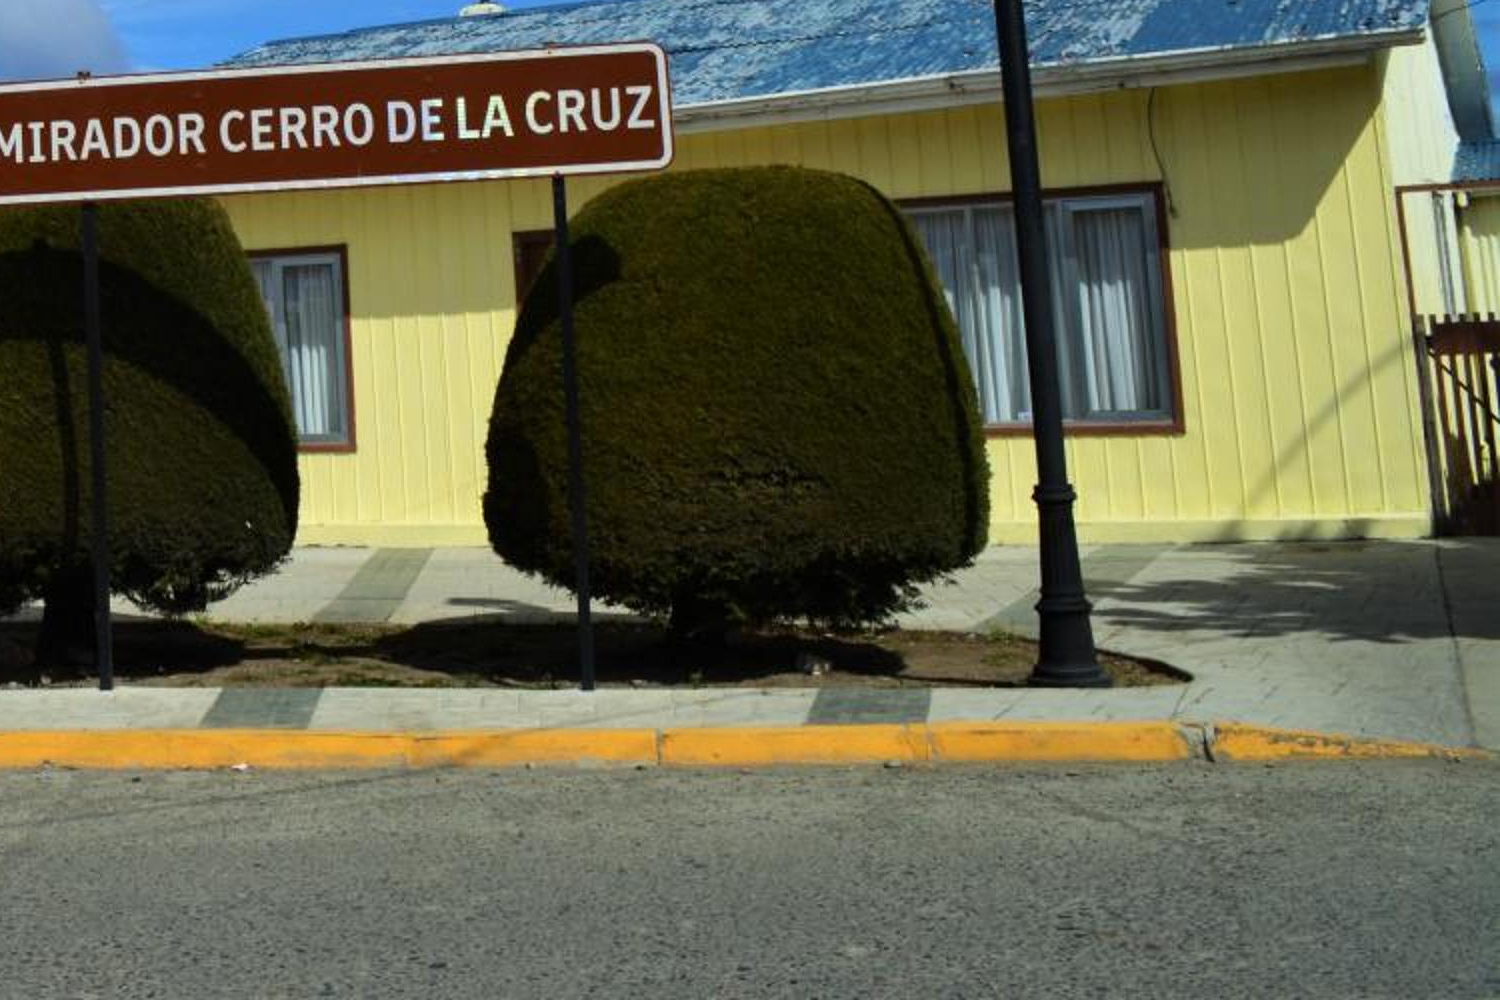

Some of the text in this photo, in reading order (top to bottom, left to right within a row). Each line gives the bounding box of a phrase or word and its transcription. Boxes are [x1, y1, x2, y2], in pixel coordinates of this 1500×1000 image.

[219, 103, 375, 152] CERRO
[386, 98, 445, 143] DE
[456, 94, 515, 140] LA
[525, 85, 655, 134] CRUZ
